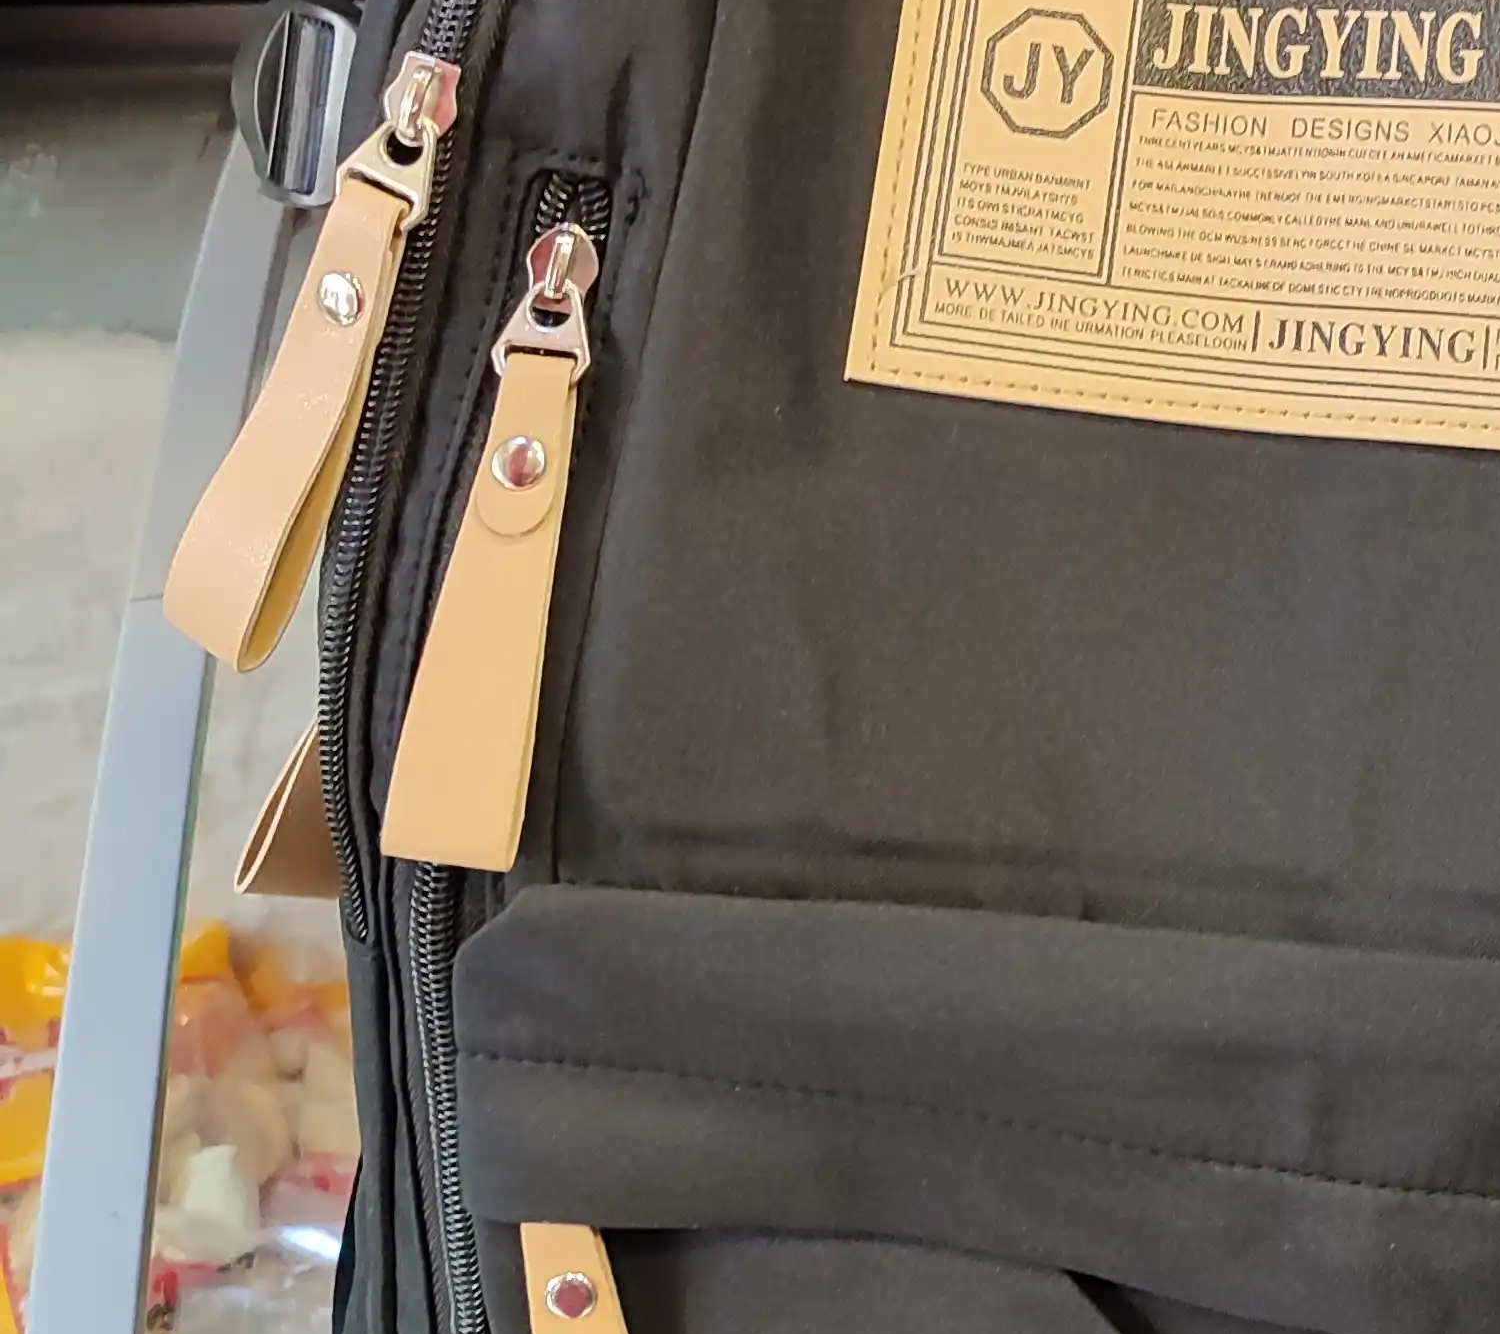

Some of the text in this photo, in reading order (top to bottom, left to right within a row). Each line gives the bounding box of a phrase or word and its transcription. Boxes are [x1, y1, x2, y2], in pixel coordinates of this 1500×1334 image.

[1153, 2, 1485, 84] JINGYING
[1003, 41, 1095, 104] JY
[1151, 108, 1268, 137] FASHION
[1291, 117, 1411, 143] DESIGNS
[945, 277, 1245, 335] WWW.JINGYING.COM
[1268, 317, 1476, 365] JINGYING
